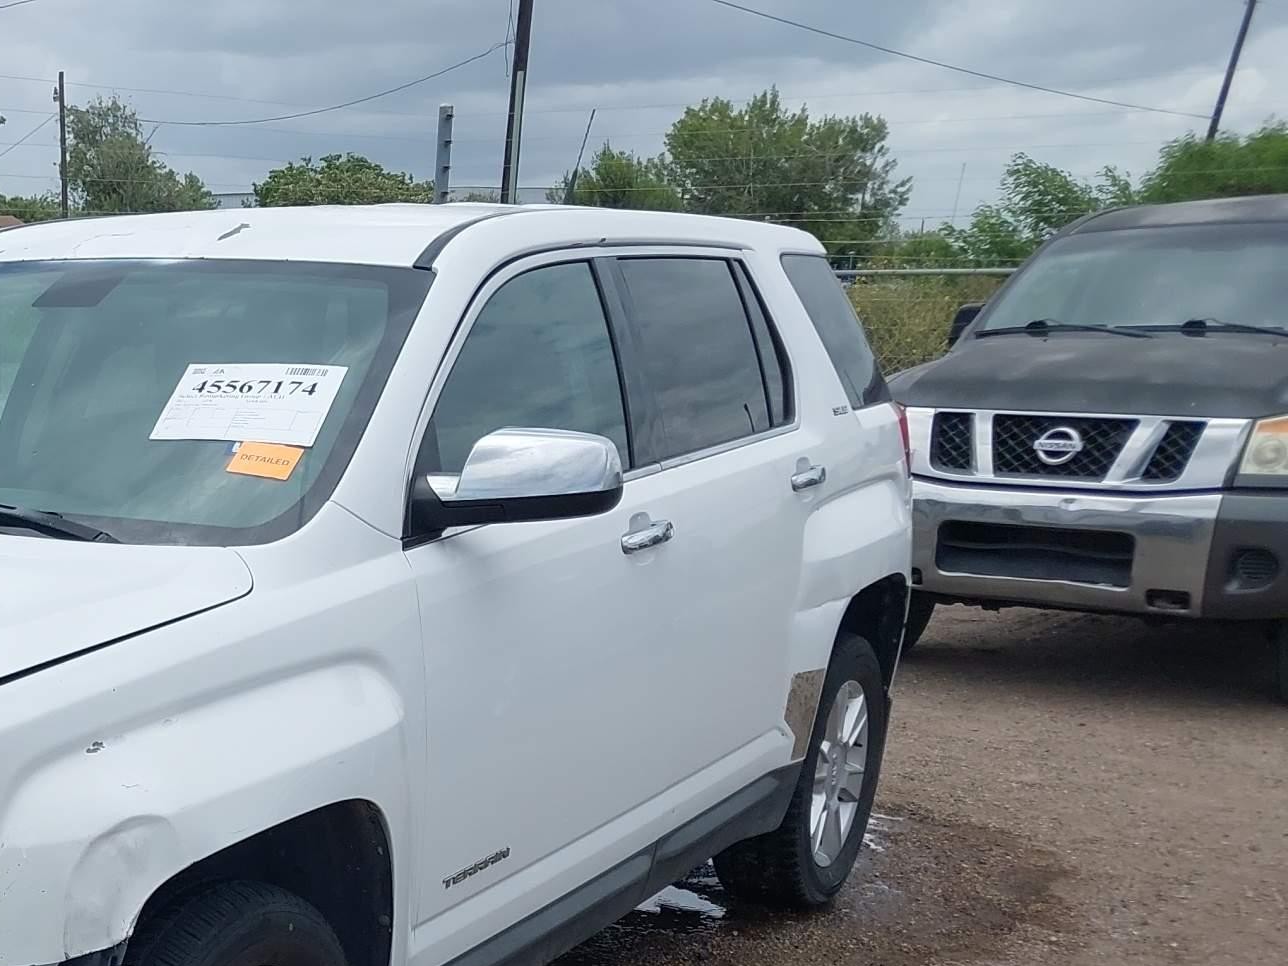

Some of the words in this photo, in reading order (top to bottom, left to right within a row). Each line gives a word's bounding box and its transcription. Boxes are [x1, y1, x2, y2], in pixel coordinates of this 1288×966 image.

[192, 379, 318, 396] 45567174
[1037, 441, 1076, 450] NISSAN
[240, 454, 290, 466] DETAILED
[442, 847, 510, 889] TERRAIN
